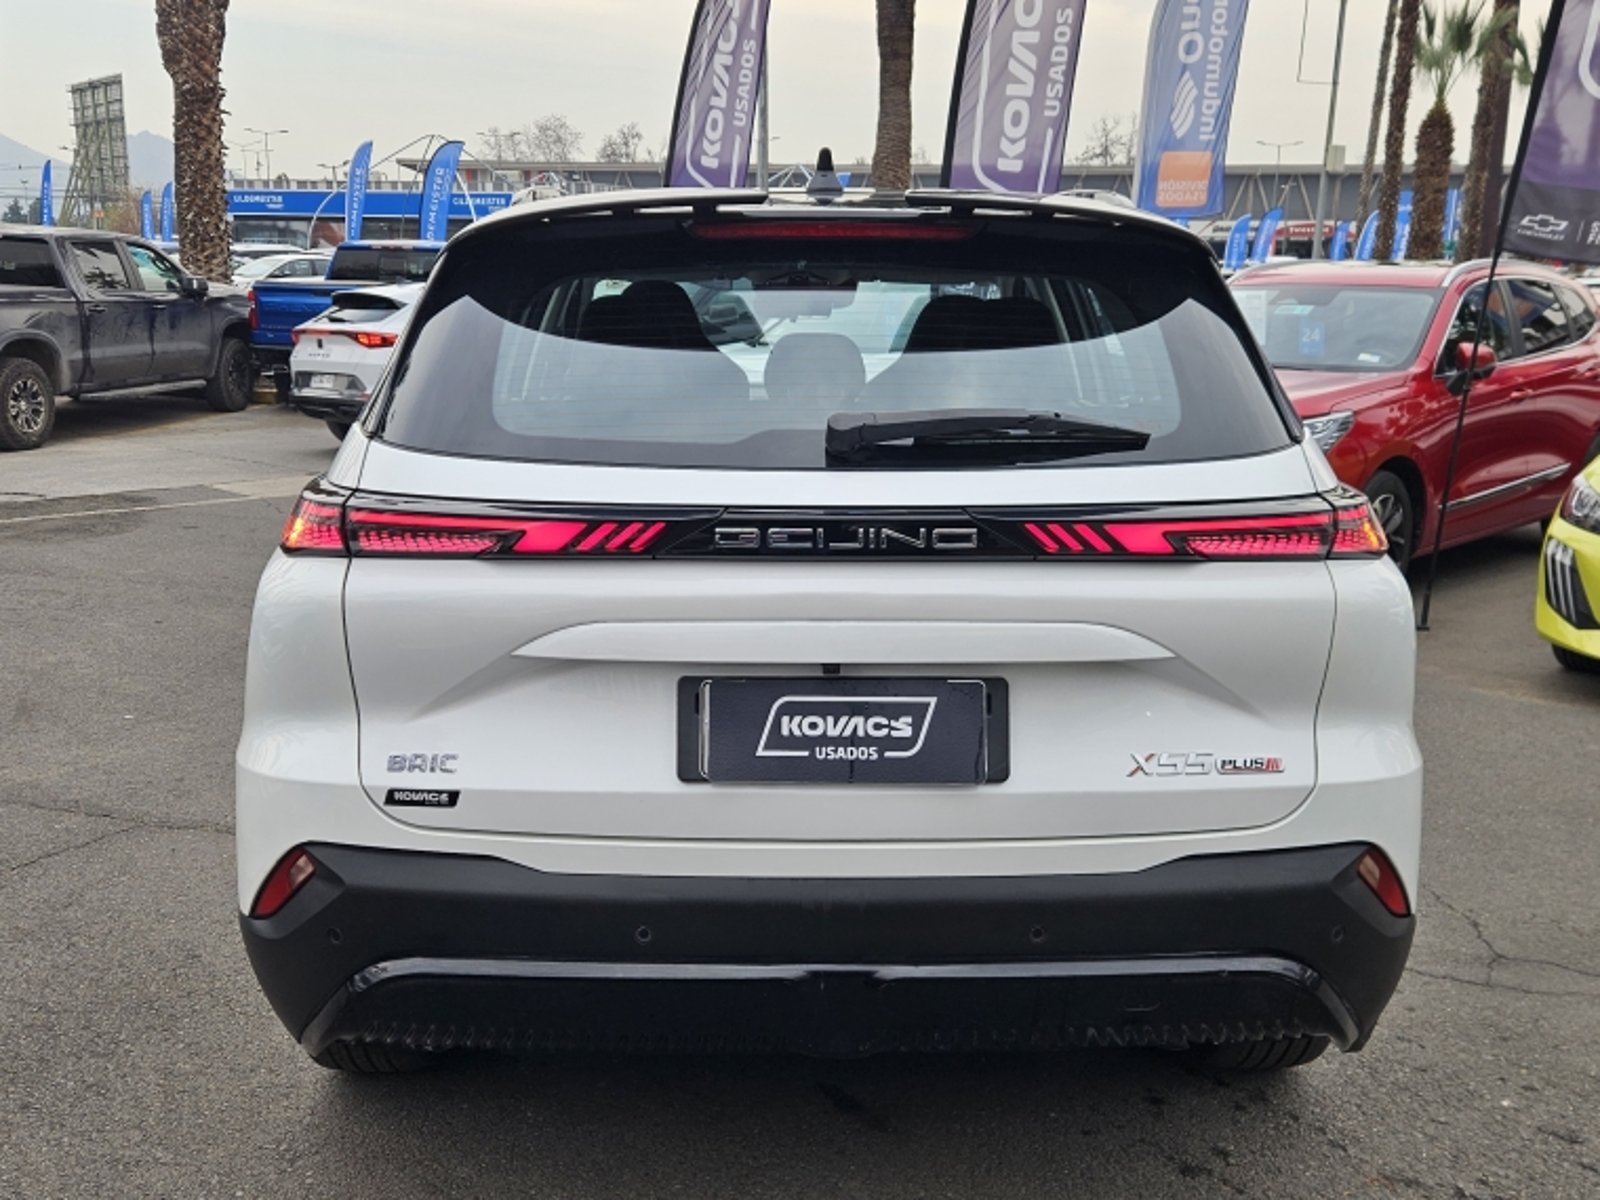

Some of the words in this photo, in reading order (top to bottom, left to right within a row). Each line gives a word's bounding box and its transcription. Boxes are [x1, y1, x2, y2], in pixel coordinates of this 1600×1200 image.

[1044, 8, 1073, 117] USADOS
[733, 39, 757, 127] USADOS
[1302, 328, 1321, 342] 24
[780, 715, 913, 738] KOVACS
[386, 753, 459, 774] BAIC
[815, 746, 879, 761] USADOS
[1126, 753, 1213, 777] X55
